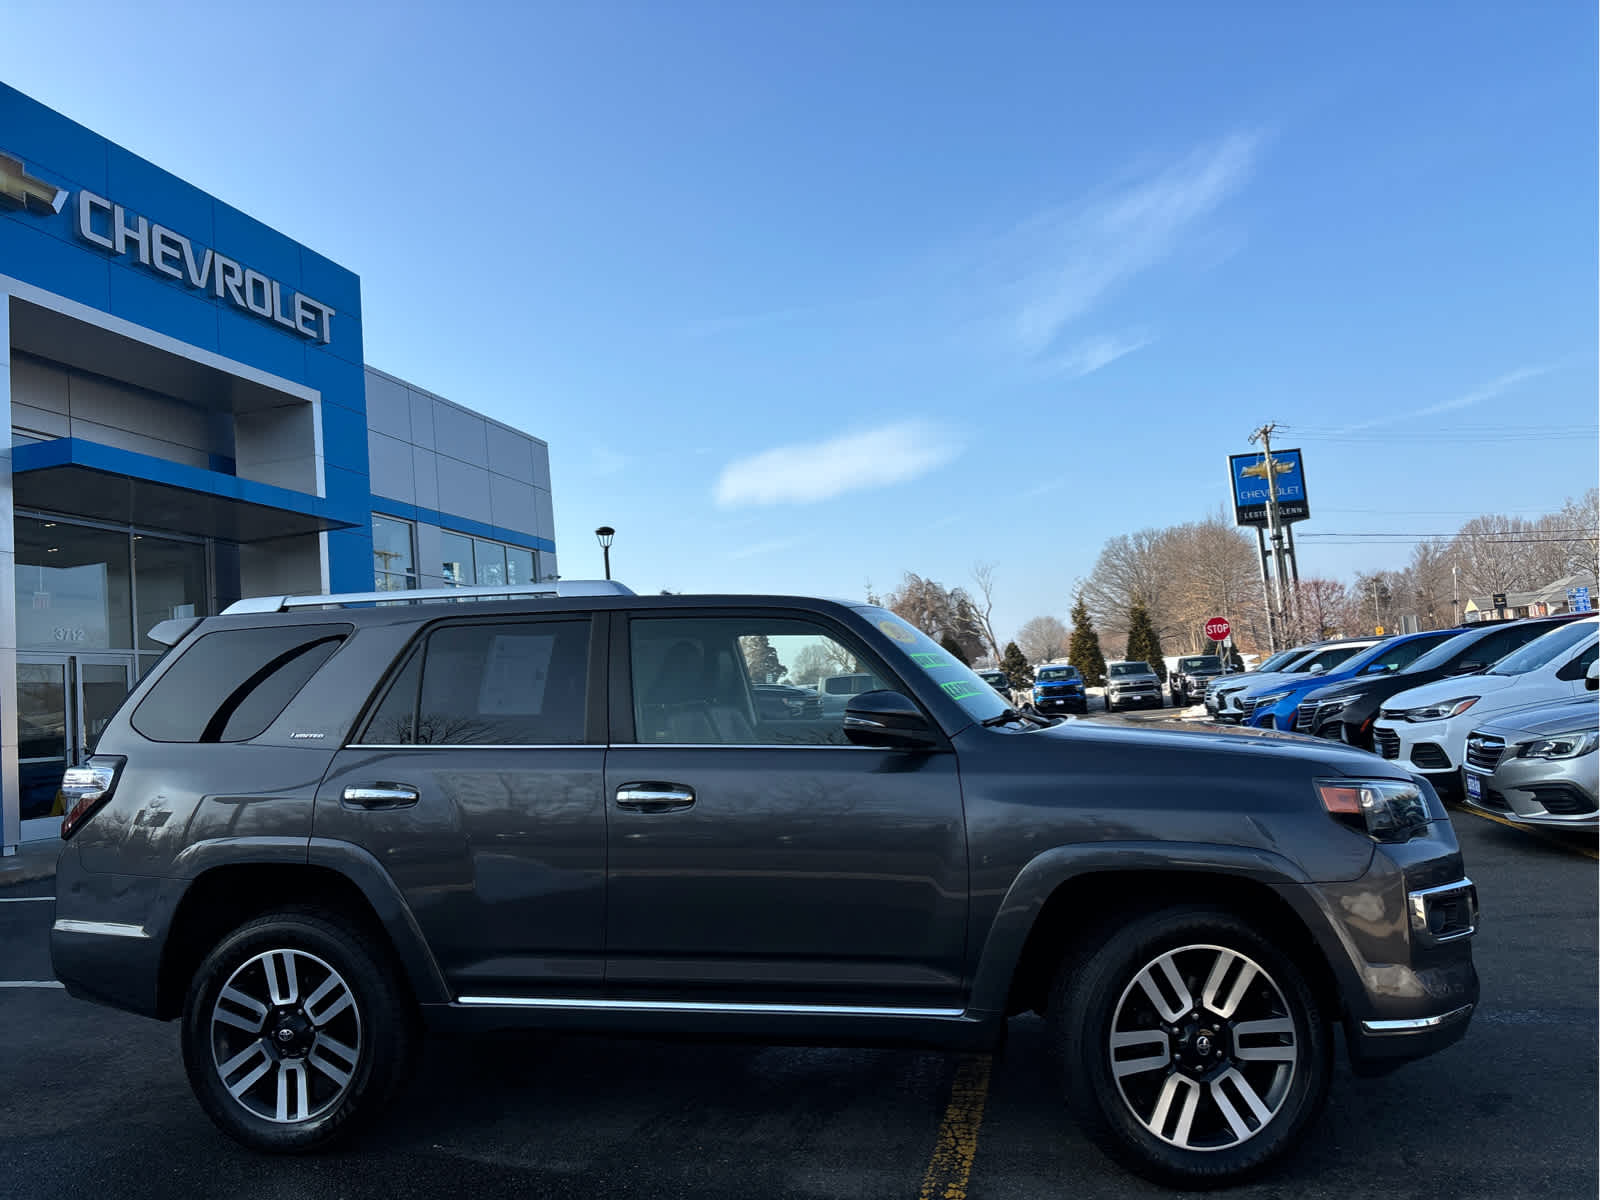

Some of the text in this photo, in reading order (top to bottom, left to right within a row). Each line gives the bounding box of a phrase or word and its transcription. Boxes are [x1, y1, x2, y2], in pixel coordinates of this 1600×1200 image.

[77, 189, 335, 345] CHEVROLET
[1240, 486, 1299, 500] CHEVOLET
[1244, 510, 1273, 519] LESTE
[55, 628, 85, 640] 3712
[1207, 623, 1229, 634] STOP
